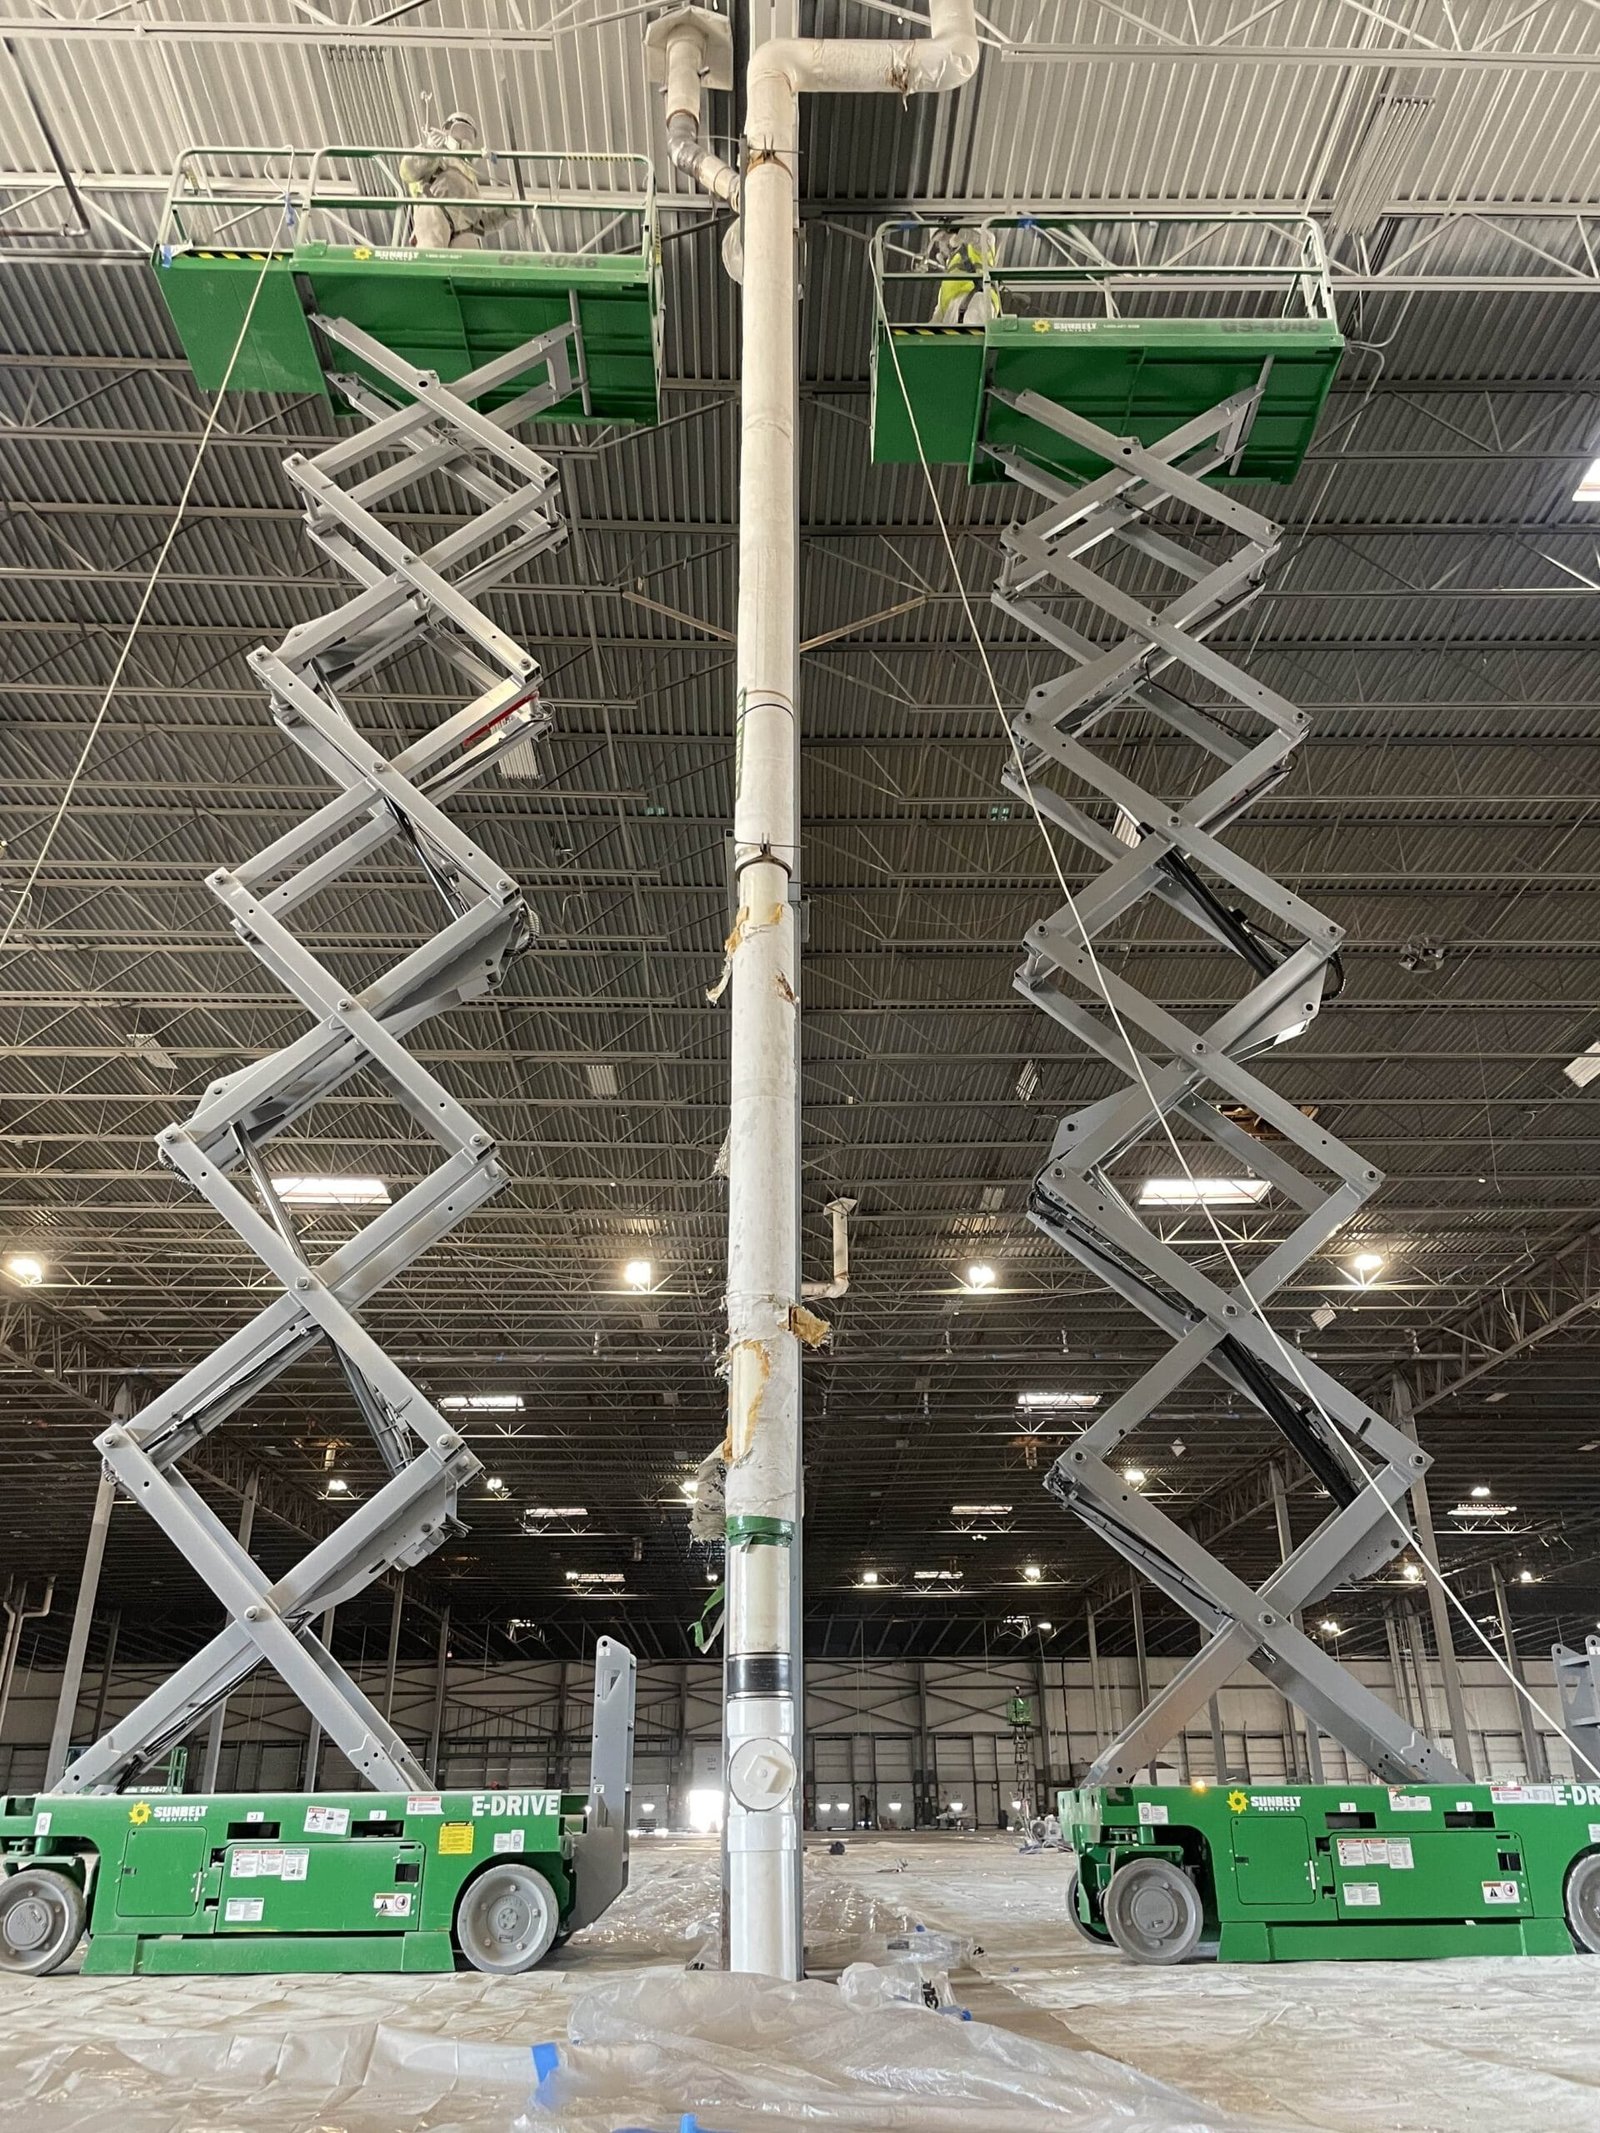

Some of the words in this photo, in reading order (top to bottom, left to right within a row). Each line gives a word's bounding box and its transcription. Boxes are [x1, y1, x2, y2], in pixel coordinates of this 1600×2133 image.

[472, 1795, 559, 1816] E-DRIVE
[1251, 1796, 1302, 1807] SUNBELT
[153, 1806, 208, 1818] SUNBELT
